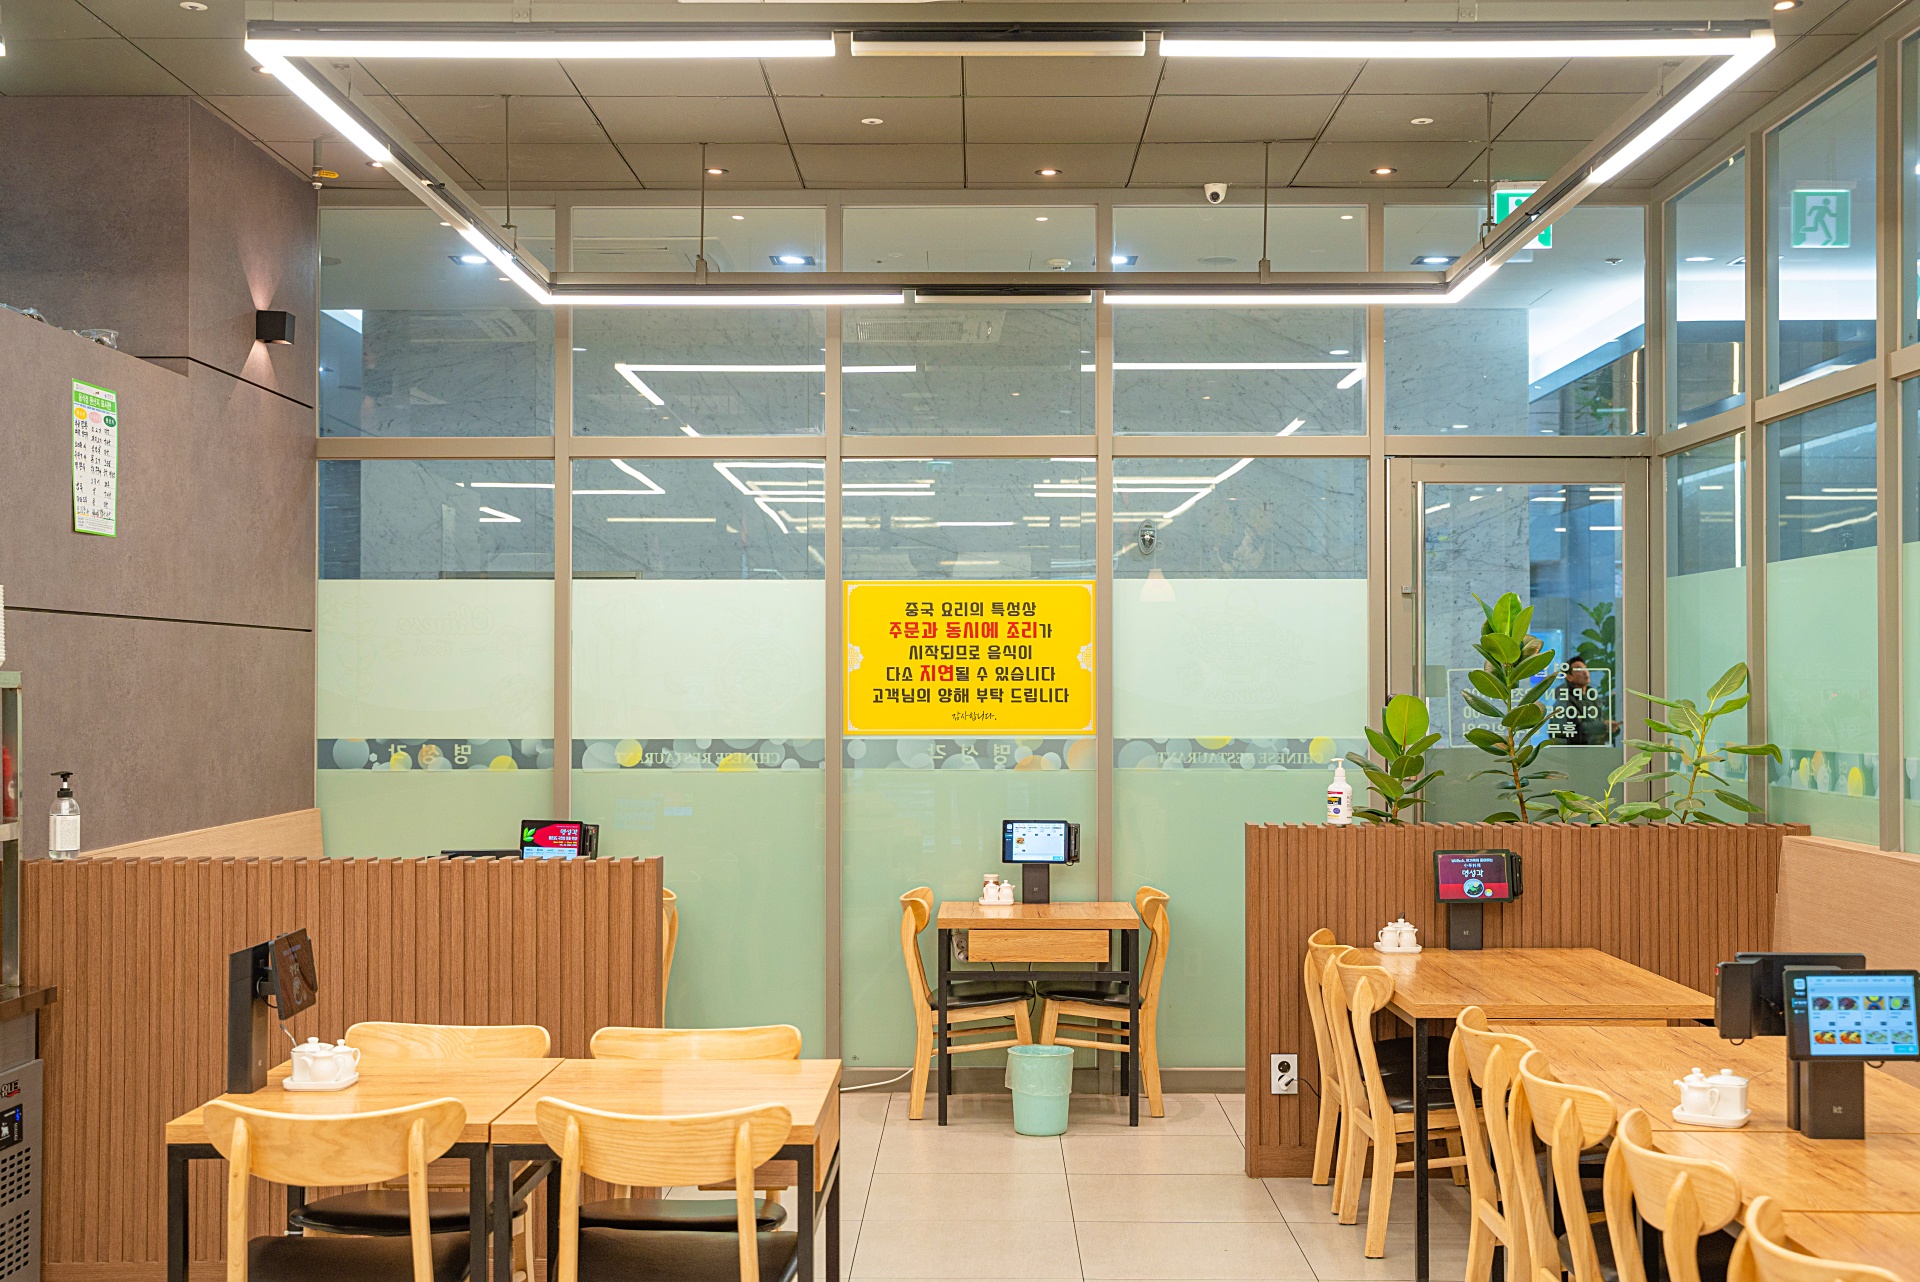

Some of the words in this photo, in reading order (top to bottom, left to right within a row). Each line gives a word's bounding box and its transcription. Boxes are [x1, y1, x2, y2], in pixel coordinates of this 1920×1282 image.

[904, 601, 935, 617] 중국
[941, 601, 984, 617] 요리의
[991, 601, 1037, 617] 특성상
[889, 621, 938, 639] 주문과
[946, 621, 999, 639] 동시에
[1006, 621, 1053, 639] 조리가
[909, 645, 981, 660] 시작되므로
[987, 645, 1032, 660] 음식이
[886, 666, 913, 682] 다소
[919, 664, 970, 682] 지연될
[976, 666, 988, 682] 수
[995, 666, 1056, 682] 있습니다
[872, 688, 931, 703] 고객님의
[937, 688, 970, 703] 양해
[976, 688, 1004, 703] 부탁
[1010, 688, 1070, 703] 드립니다
[951, 710, 998, 722] 감사합니다.
[1832, 1105, 1843, 1114] kt
